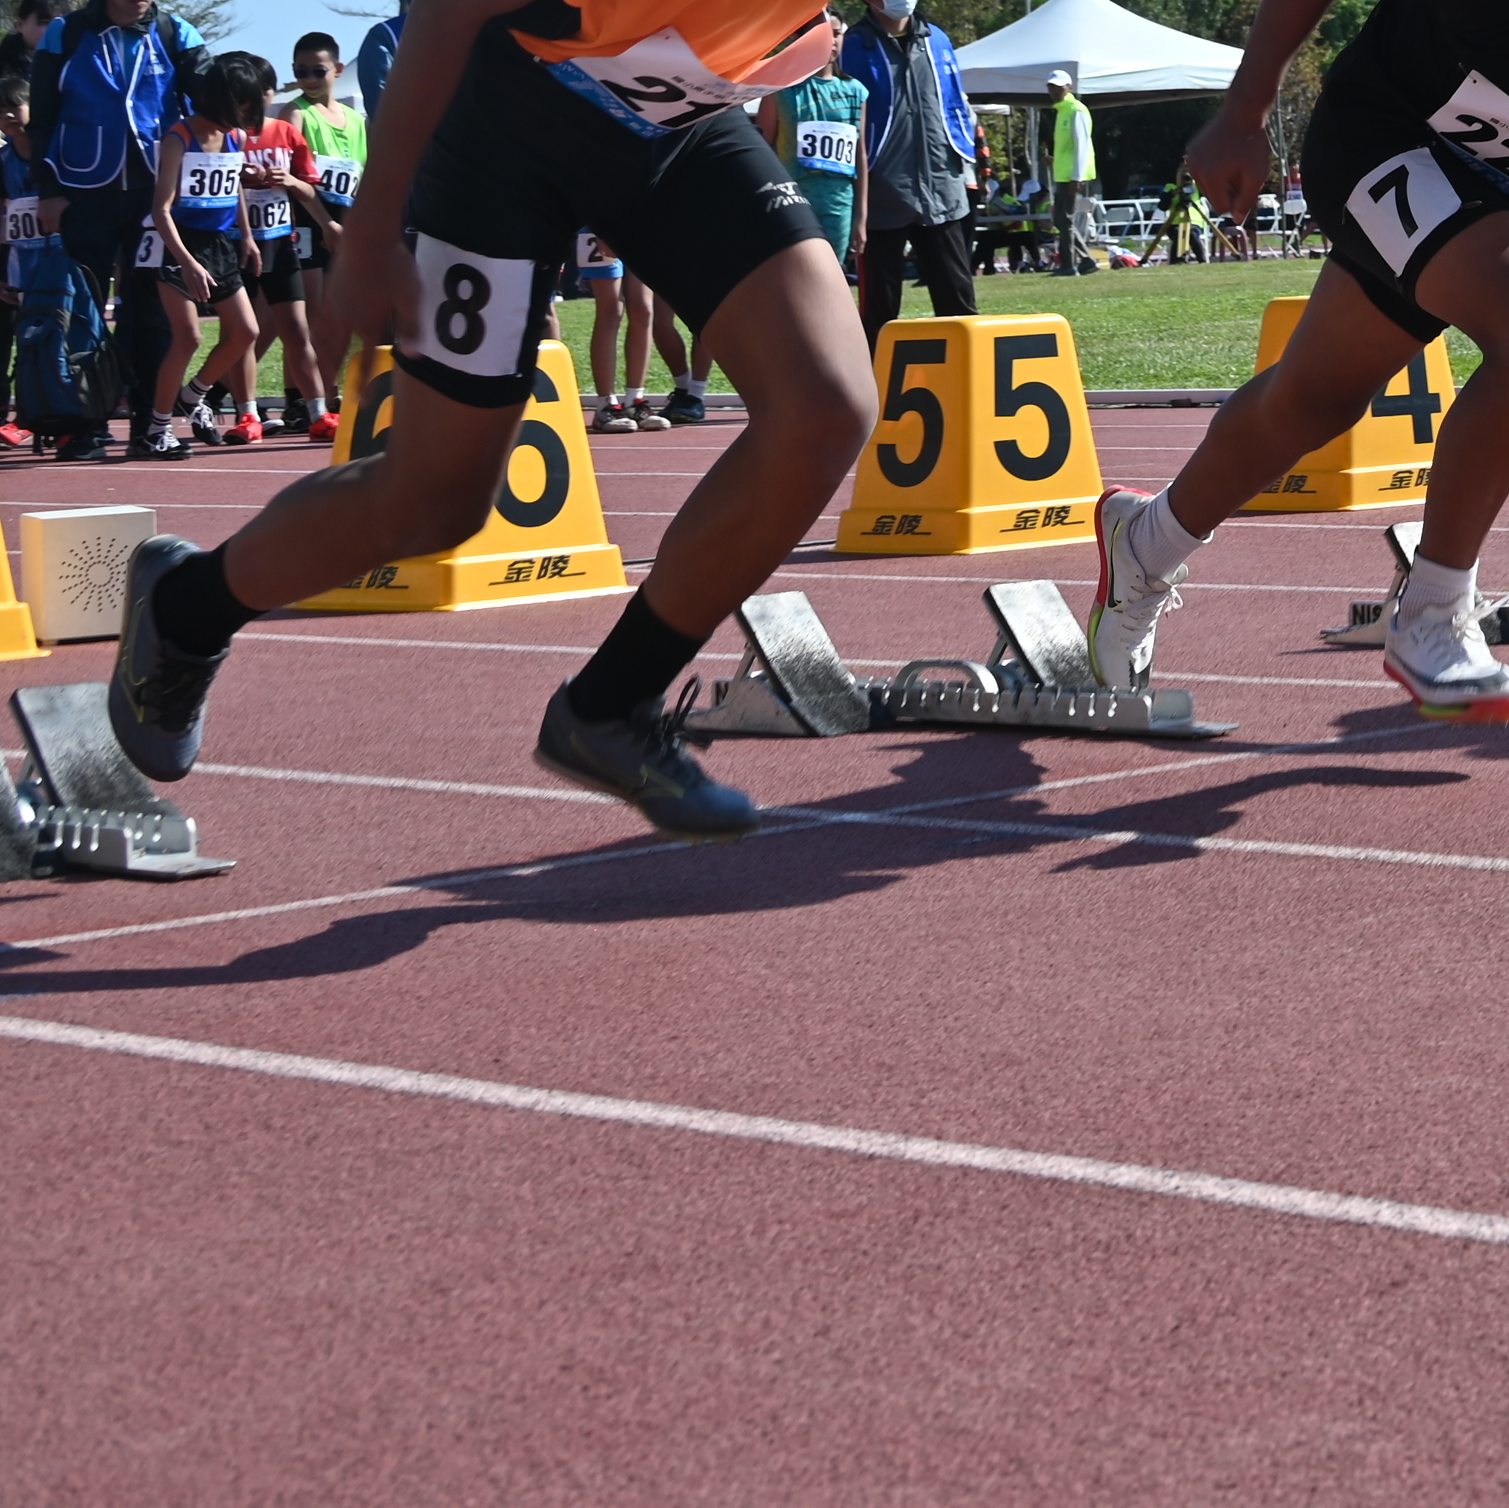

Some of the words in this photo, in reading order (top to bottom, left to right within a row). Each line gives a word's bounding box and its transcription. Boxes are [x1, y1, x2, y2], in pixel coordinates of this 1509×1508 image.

[802, 134, 853, 164] 3003
[1373, 172, 1437, 239] 7
[9, 213, 46, 240] 30
[139, 236, 153, 263] 3
[587, 237, 604, 262] 2
[434, 263, 491, 355] 8
[994, 334, 1071, 481] 5
[1371, 349, 1442, 444] 4
[877, 339, 947, 486] 5
[494, 367, 570, 528] 6
[860, 515, 932, 535] 金陵
[1000, 506, 1085, 532] 金陵
[488, 555, 586, 586] 金陵
